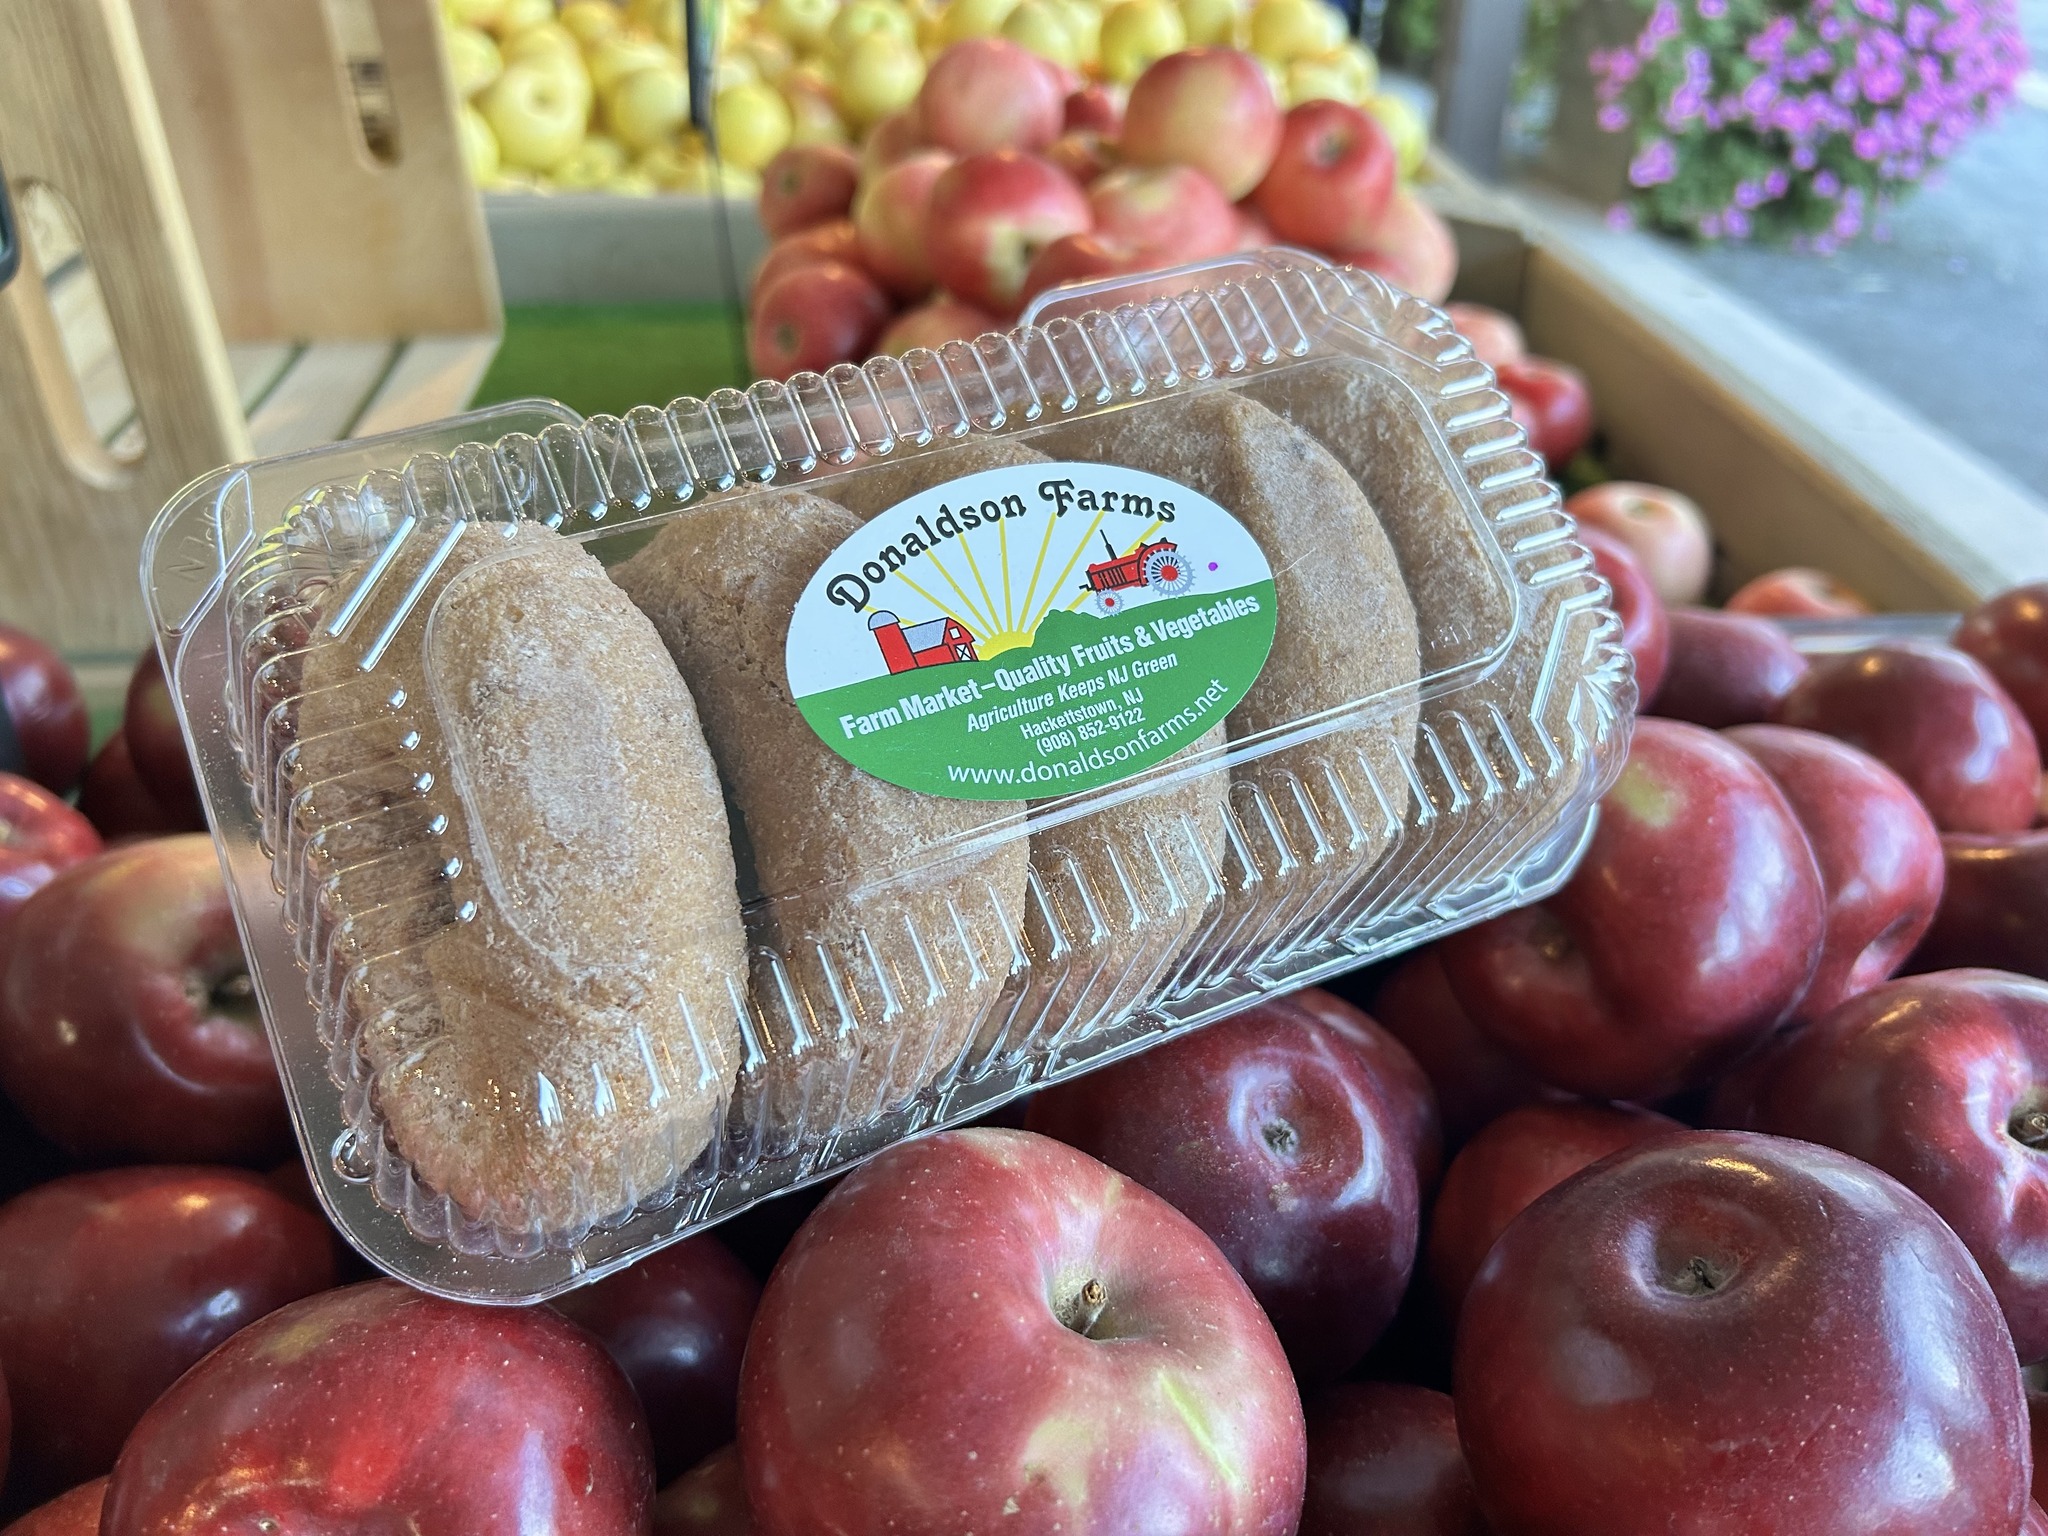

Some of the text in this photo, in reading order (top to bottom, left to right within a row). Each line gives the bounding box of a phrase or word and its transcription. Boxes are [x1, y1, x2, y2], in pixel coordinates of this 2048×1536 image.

[826, 478, 1176, 613] Donaldson Farms
[839, 705, 902, 739] Farm
[1071, 634, 1135, 667] Fruits
[1133, 625, 1155, 648] &
[1149, 595, 1260, 641] Vegetables
[967, 652, 1178, 732] Agriculture Keeps NJ Green
[1020, 686, 1144, 739] Hackettstown, NJ
[948, 677, 1229, 785] www.donaldsonfarms.net
[1036, 707, 1146, 757] (908) 852-9122
